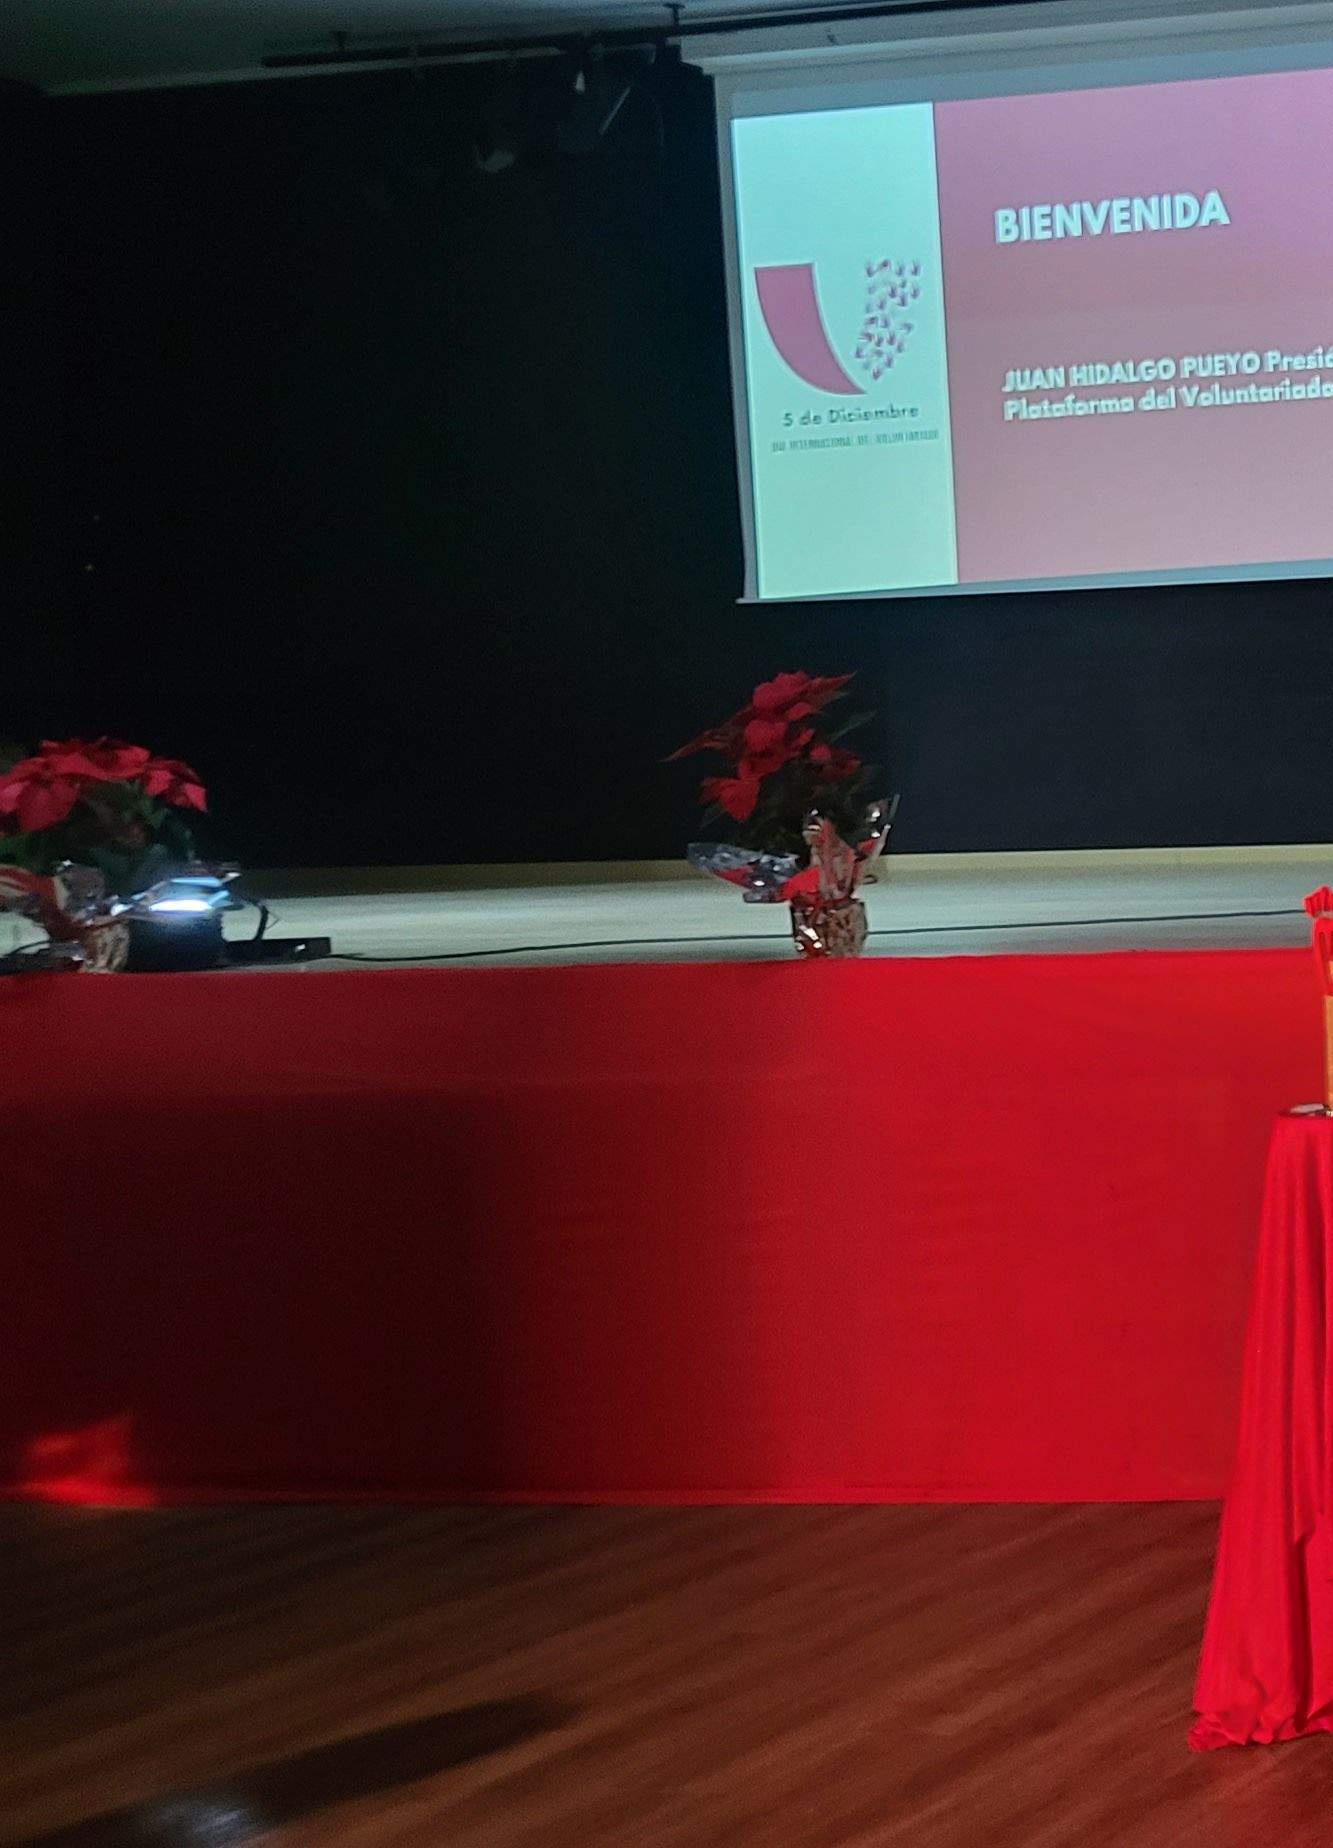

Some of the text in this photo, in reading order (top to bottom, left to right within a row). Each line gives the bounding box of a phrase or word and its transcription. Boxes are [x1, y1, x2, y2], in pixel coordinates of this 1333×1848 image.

[995, 188, 1231, 244] BIENVENIDA
[1001, 365, 1065, 392] JUAN
[1069, 357, 1176, 386] HIDALGO
[1180, 352, 1261, 378] PUEYO
[799, 409, 822, 425] de
[829, 403, 919, 423] Diciembre
[1004, 393, 1135, 421] Plataforma
[1139, 385, 1176, 411] del
